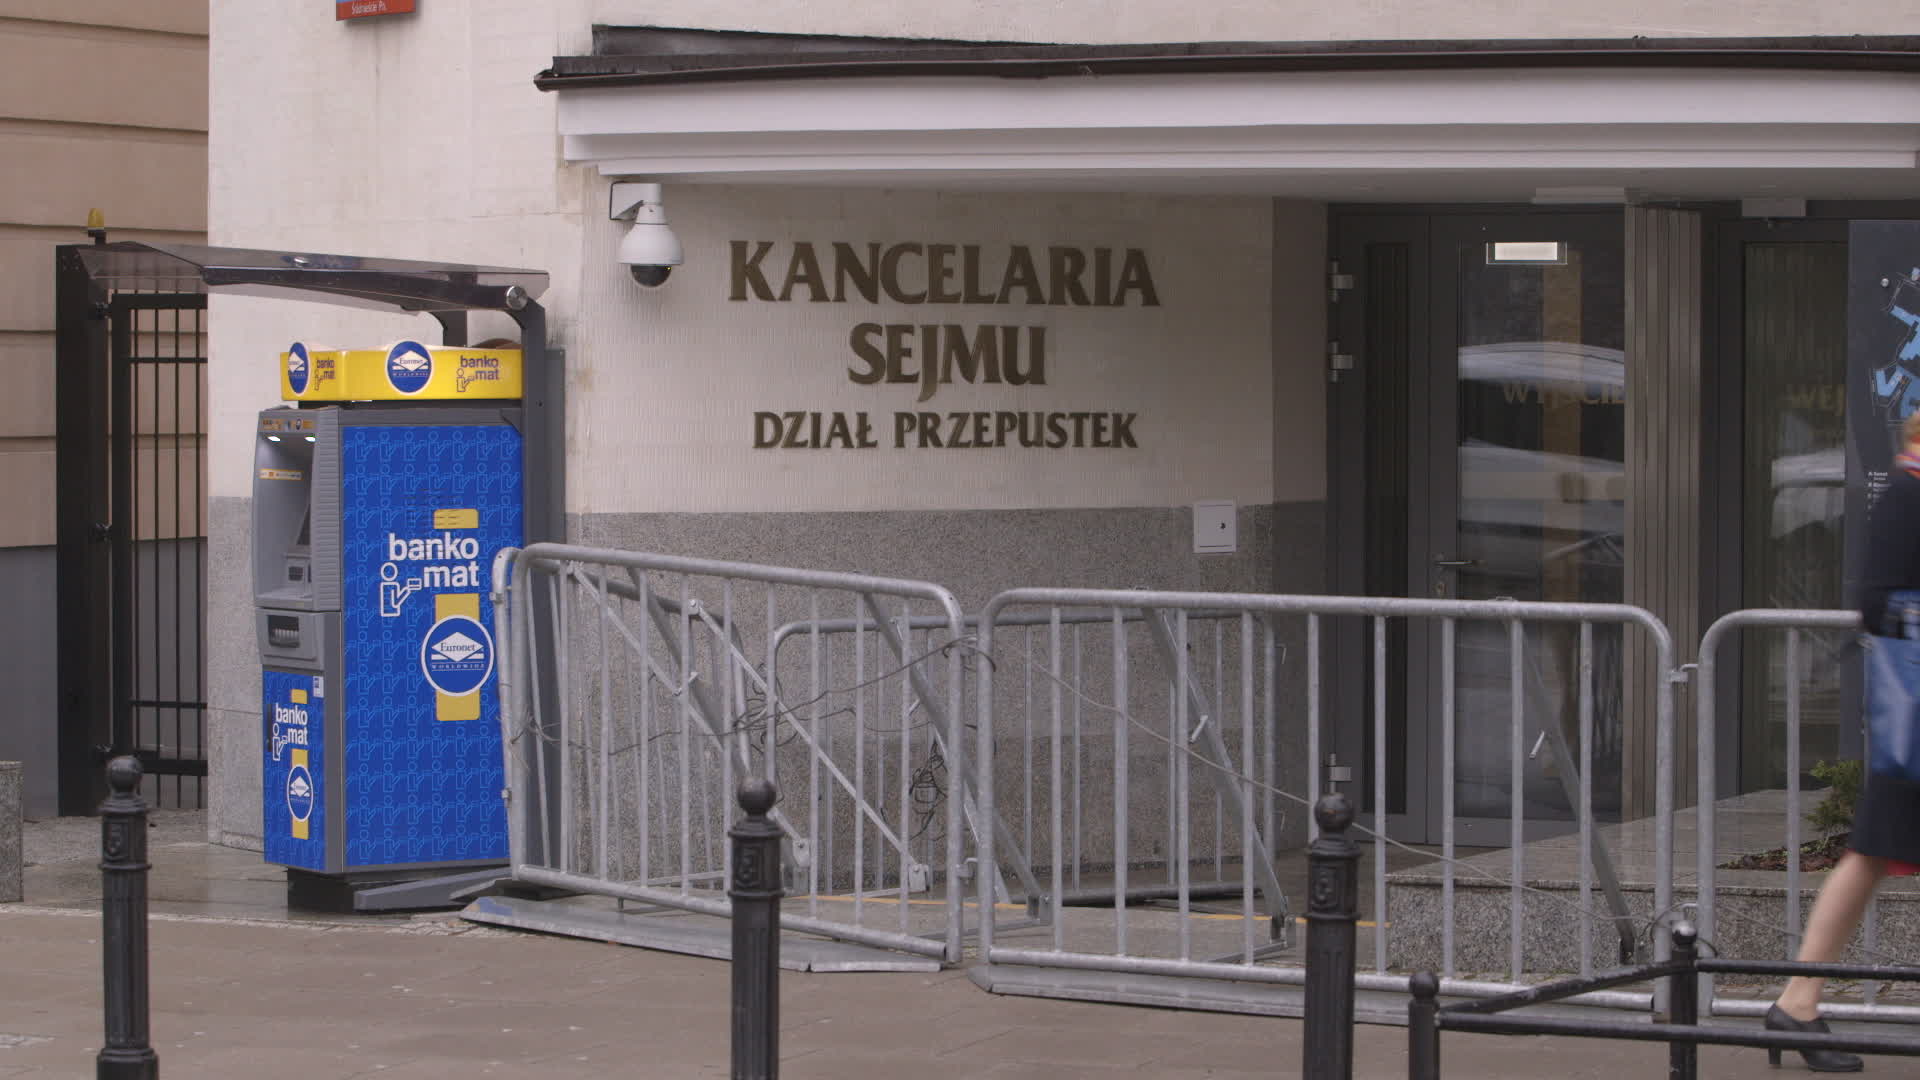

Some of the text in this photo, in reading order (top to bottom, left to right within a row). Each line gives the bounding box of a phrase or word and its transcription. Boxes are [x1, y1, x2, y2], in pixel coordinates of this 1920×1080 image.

[728, 240, 1160, 306] KANCELARIA
[460, 355, 499, 368] banko
[475, 368, 499, 380] mat
[848, 322, 1047, 403] SEJMU
[753, 411, 1138, 449] DZIAŁ PRZEPUSTEK
[388, 531, 479, 560] banko
[423, 560, 479, 588] mat
[440, 642, 476, 652] Euronet
[276, 702, 308, 725] banko
[287, 727, 308, 745] mat
